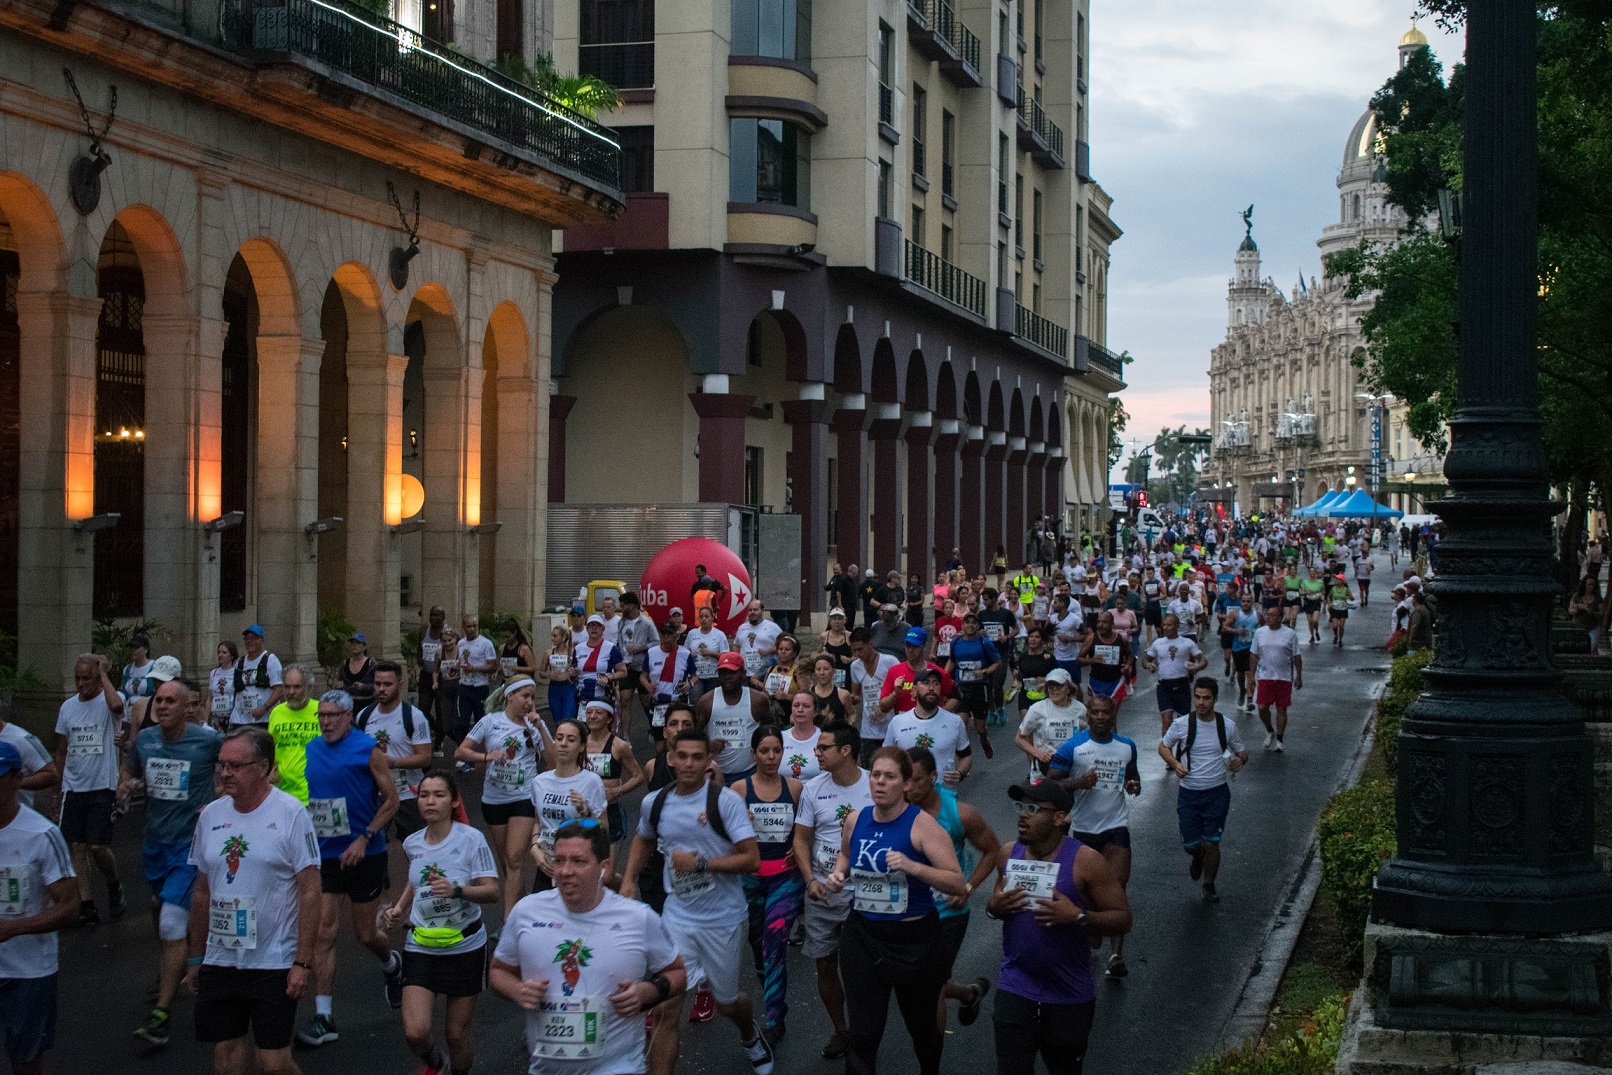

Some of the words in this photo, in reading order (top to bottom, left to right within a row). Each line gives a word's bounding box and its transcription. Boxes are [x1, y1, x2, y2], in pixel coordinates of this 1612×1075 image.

[639, 583, 668, 607] uba
[543, 793, 570, 806] FEMALE
[542, 808, 565, 820] POWER
[764, 818, 784, 826] 5346
[863, 883, 882, 893] 2168
[433, 903, 451, 913] 885
[545, 1025, 574, 1037] 2323
[586, 1018, 594, 1034] 10K
